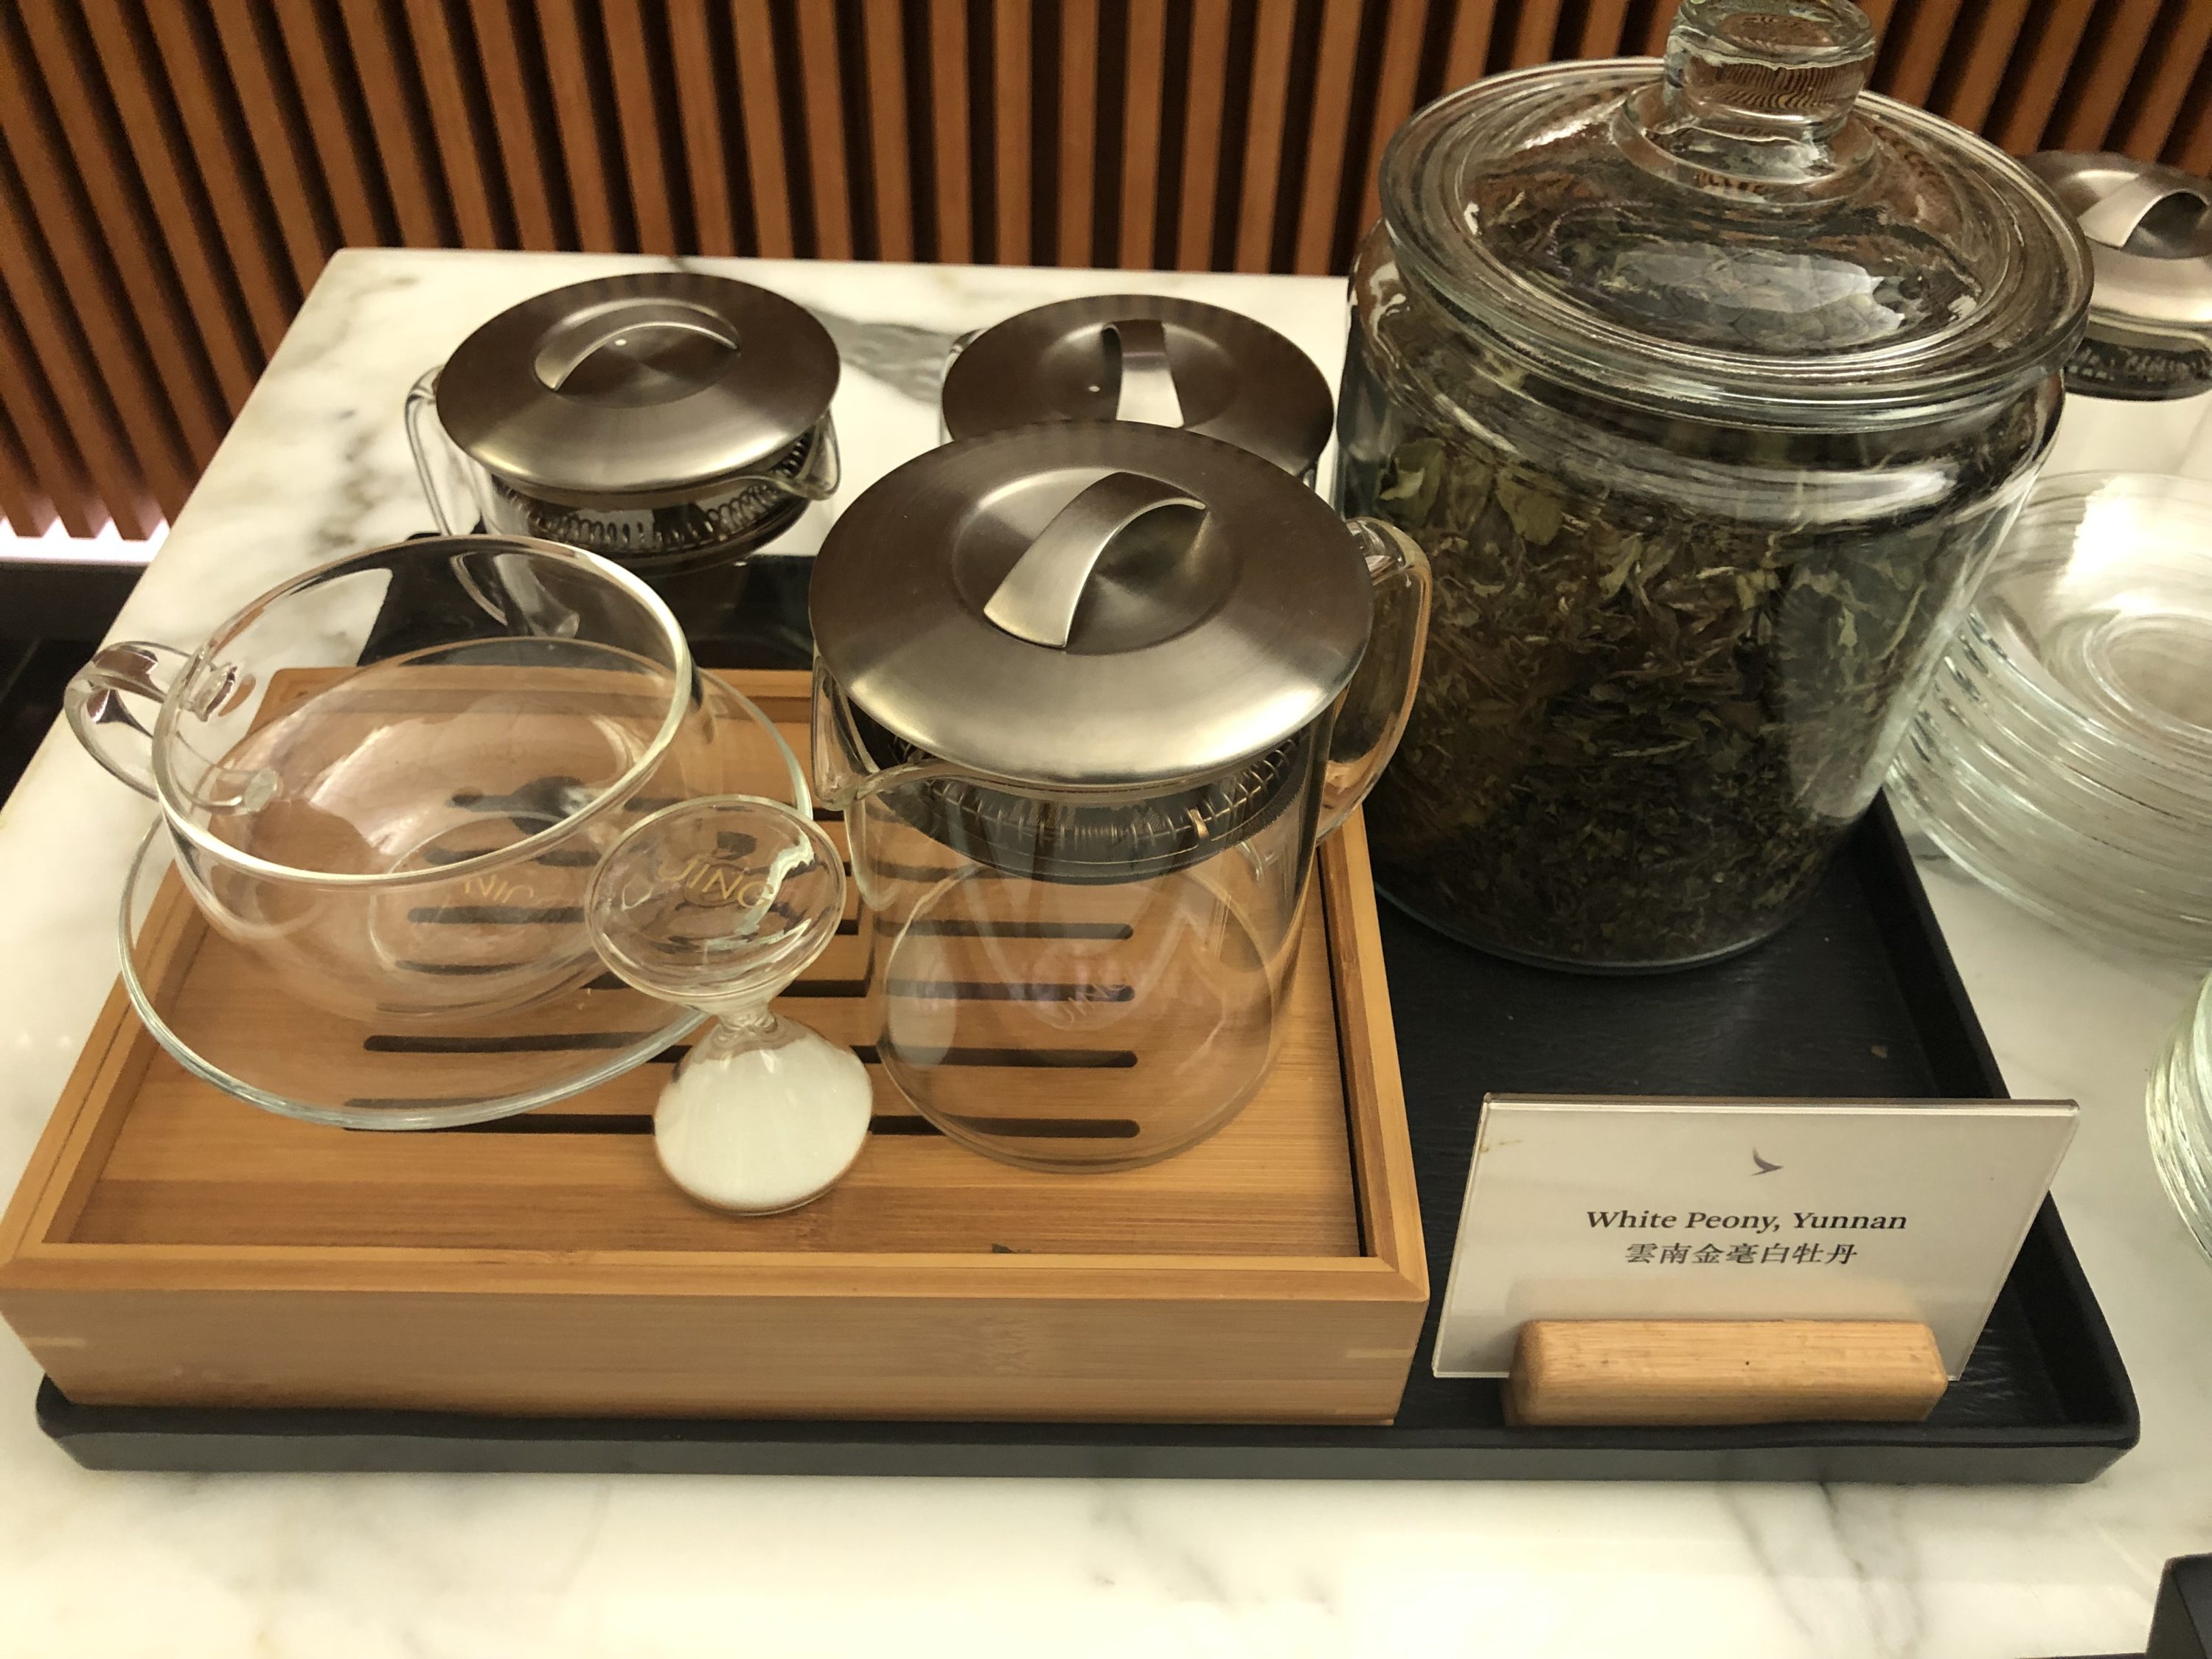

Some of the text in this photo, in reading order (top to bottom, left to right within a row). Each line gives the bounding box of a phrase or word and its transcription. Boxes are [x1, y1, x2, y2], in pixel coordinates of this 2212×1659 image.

[1586, 1209, 1907, 1234] White Peony, Yunnan
[1624, 1242, 1858, 1265] 雲南金毫白牡丹
